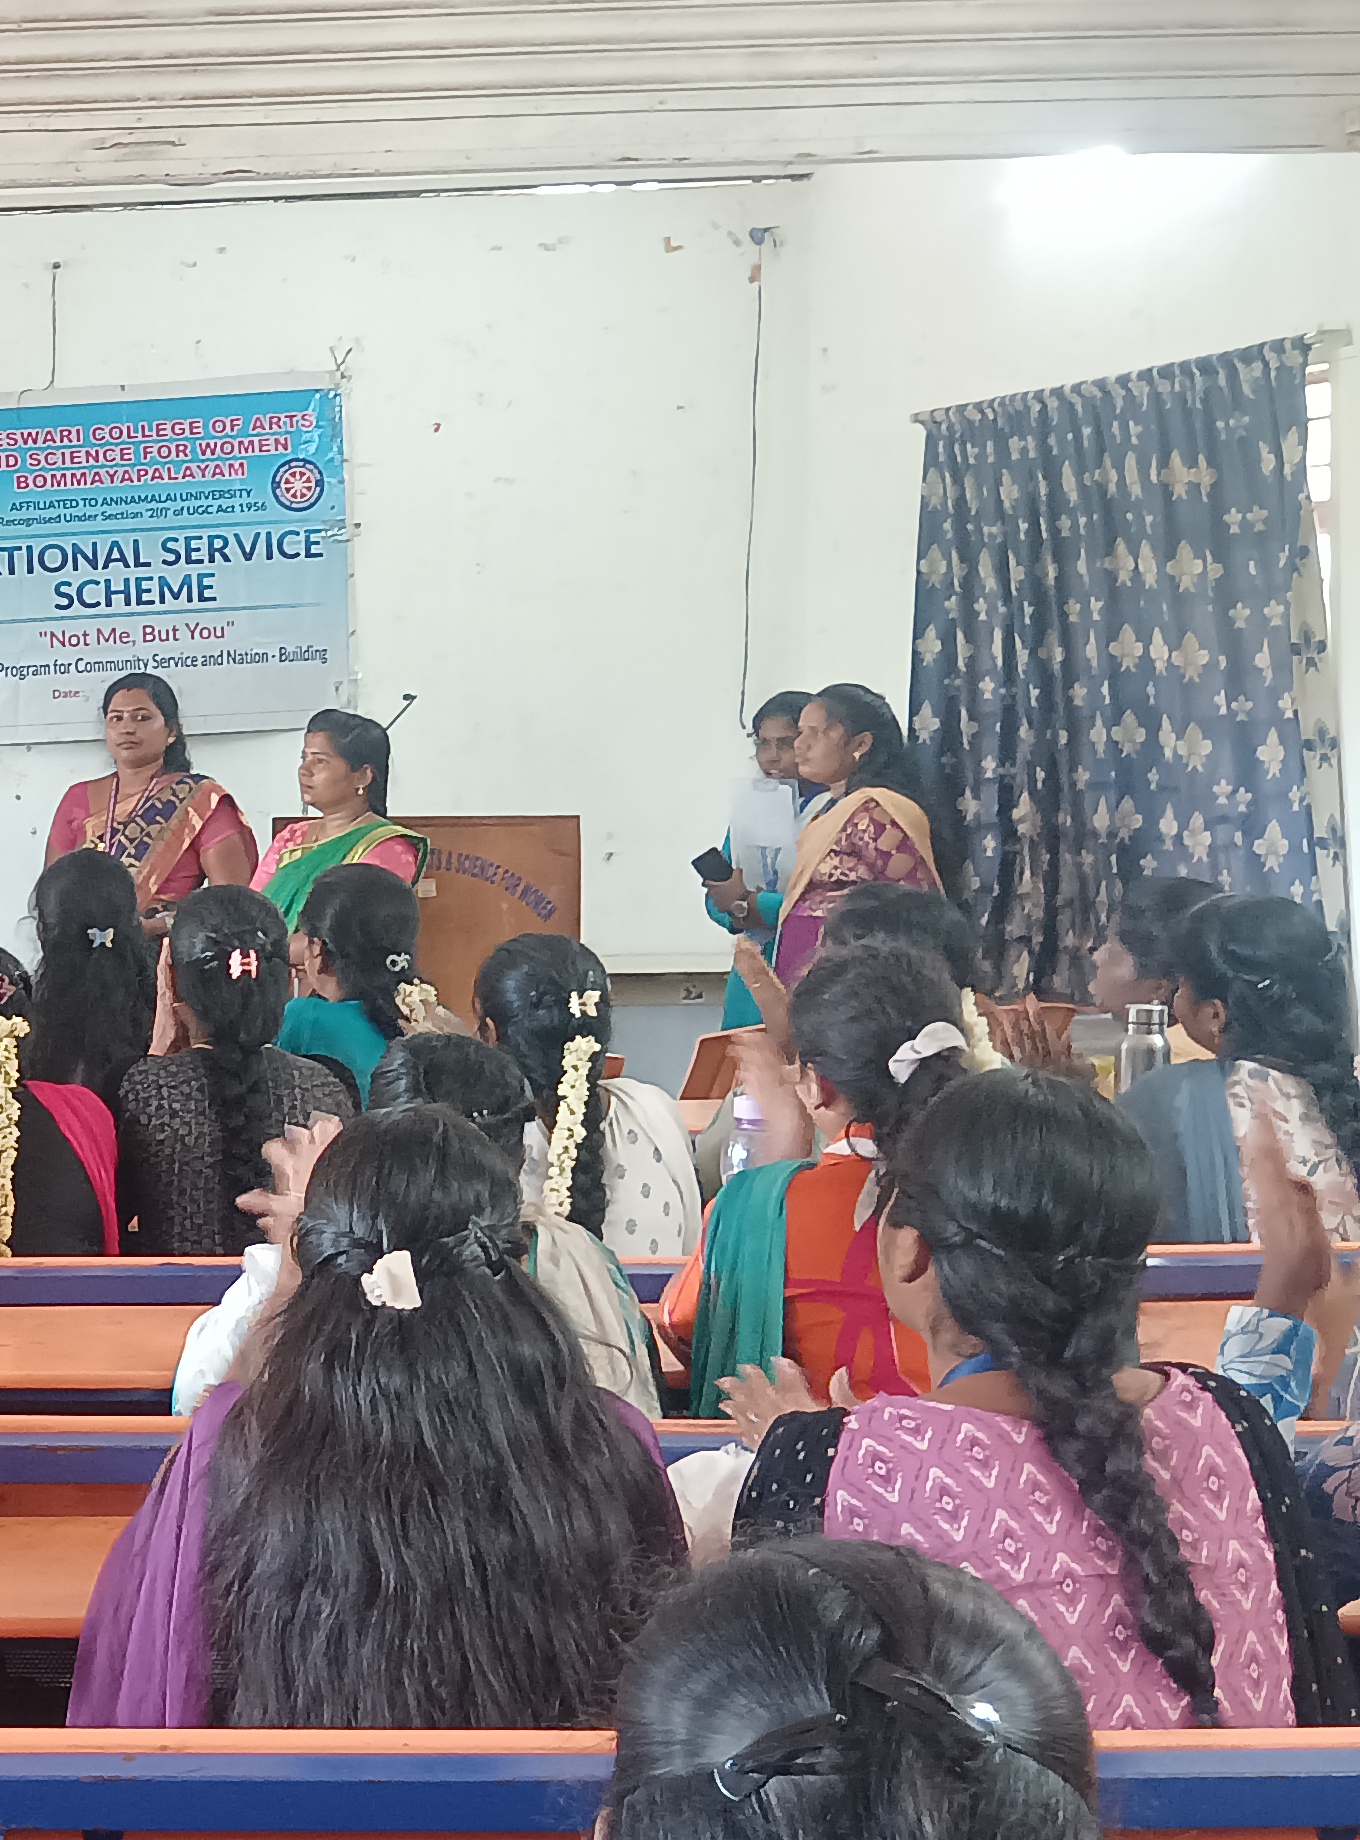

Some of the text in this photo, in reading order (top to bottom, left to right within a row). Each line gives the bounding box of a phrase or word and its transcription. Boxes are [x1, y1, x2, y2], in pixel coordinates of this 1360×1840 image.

[91, 420, 203, 444] COLLEGE
[211, 417, 244, 435] OF
[250, 411, 316, 432] ARTS
[27, 446, 135, 469] SCIENCE
[142, 443, 191, 462] FOR
[198, 436, 291, 458] WOMEN
[14, 461, 248, 492] BOMMAYAPALAYAM
[9, 487, 253, 513] AFFILIATED TO ANNAMALAI UNIVERSITY
[63, 510, 99, 524] Under
[100, 508, 144, 521] Section
[172, 506, 185, 518] of
[186, 505, 213, 517] UGC
[215, 503, 236, 515] Act
[238, 500, 268, 513] 1956
[160, 527, 325, 567] SERVICE
[53, 571, 218, 611] SCHEME
[38, 620, 236, 649] "Not Me, But You"
[53, 658, 72, 676] for
[74, 653, 150, 677] Community
[151, 650, 199, 671] Service
[200, 649, 225, 668] and
[226, 646, 270, 666] Nation
[278, 645, 328, 665] Building
